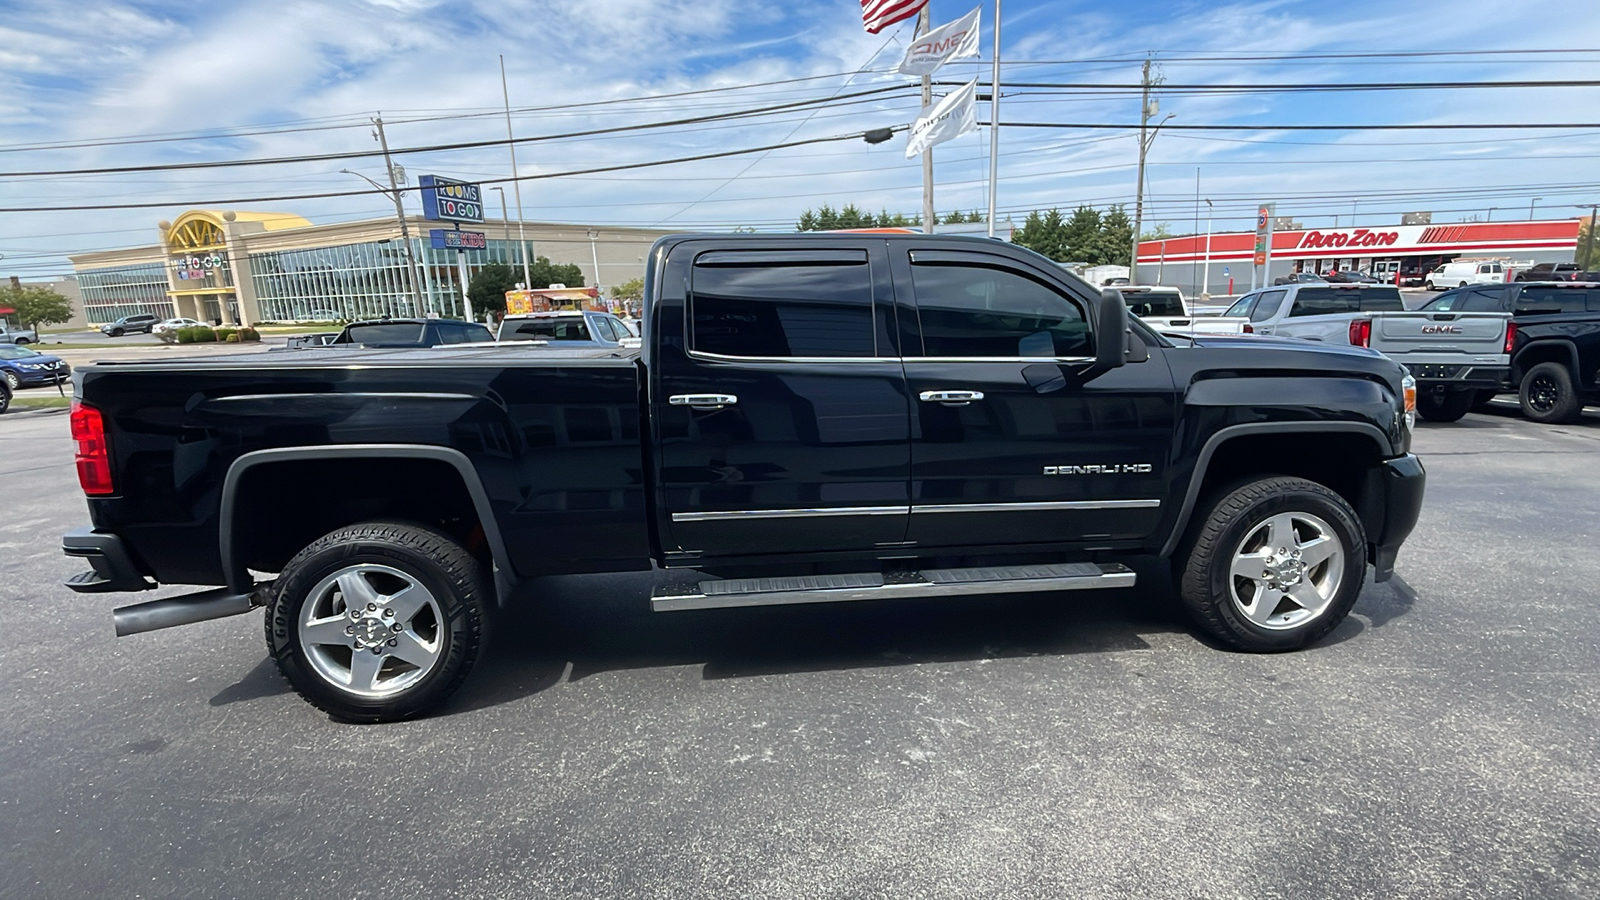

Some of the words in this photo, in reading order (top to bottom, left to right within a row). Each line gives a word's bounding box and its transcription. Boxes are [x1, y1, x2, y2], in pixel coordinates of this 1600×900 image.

[438, 181, 477, 201] ROOMS
[441, 200, 456, 215] TO
[457, 203, 474, 217] GO
[460, 232, 485, 249] KIDS
[1299, 229, 1399, 249] AutoZone
[1421, 324, 1463, 334] GMC
[1043, 464, 1120, 475] DENALI
[1122, 463, 1153, 473] HD
